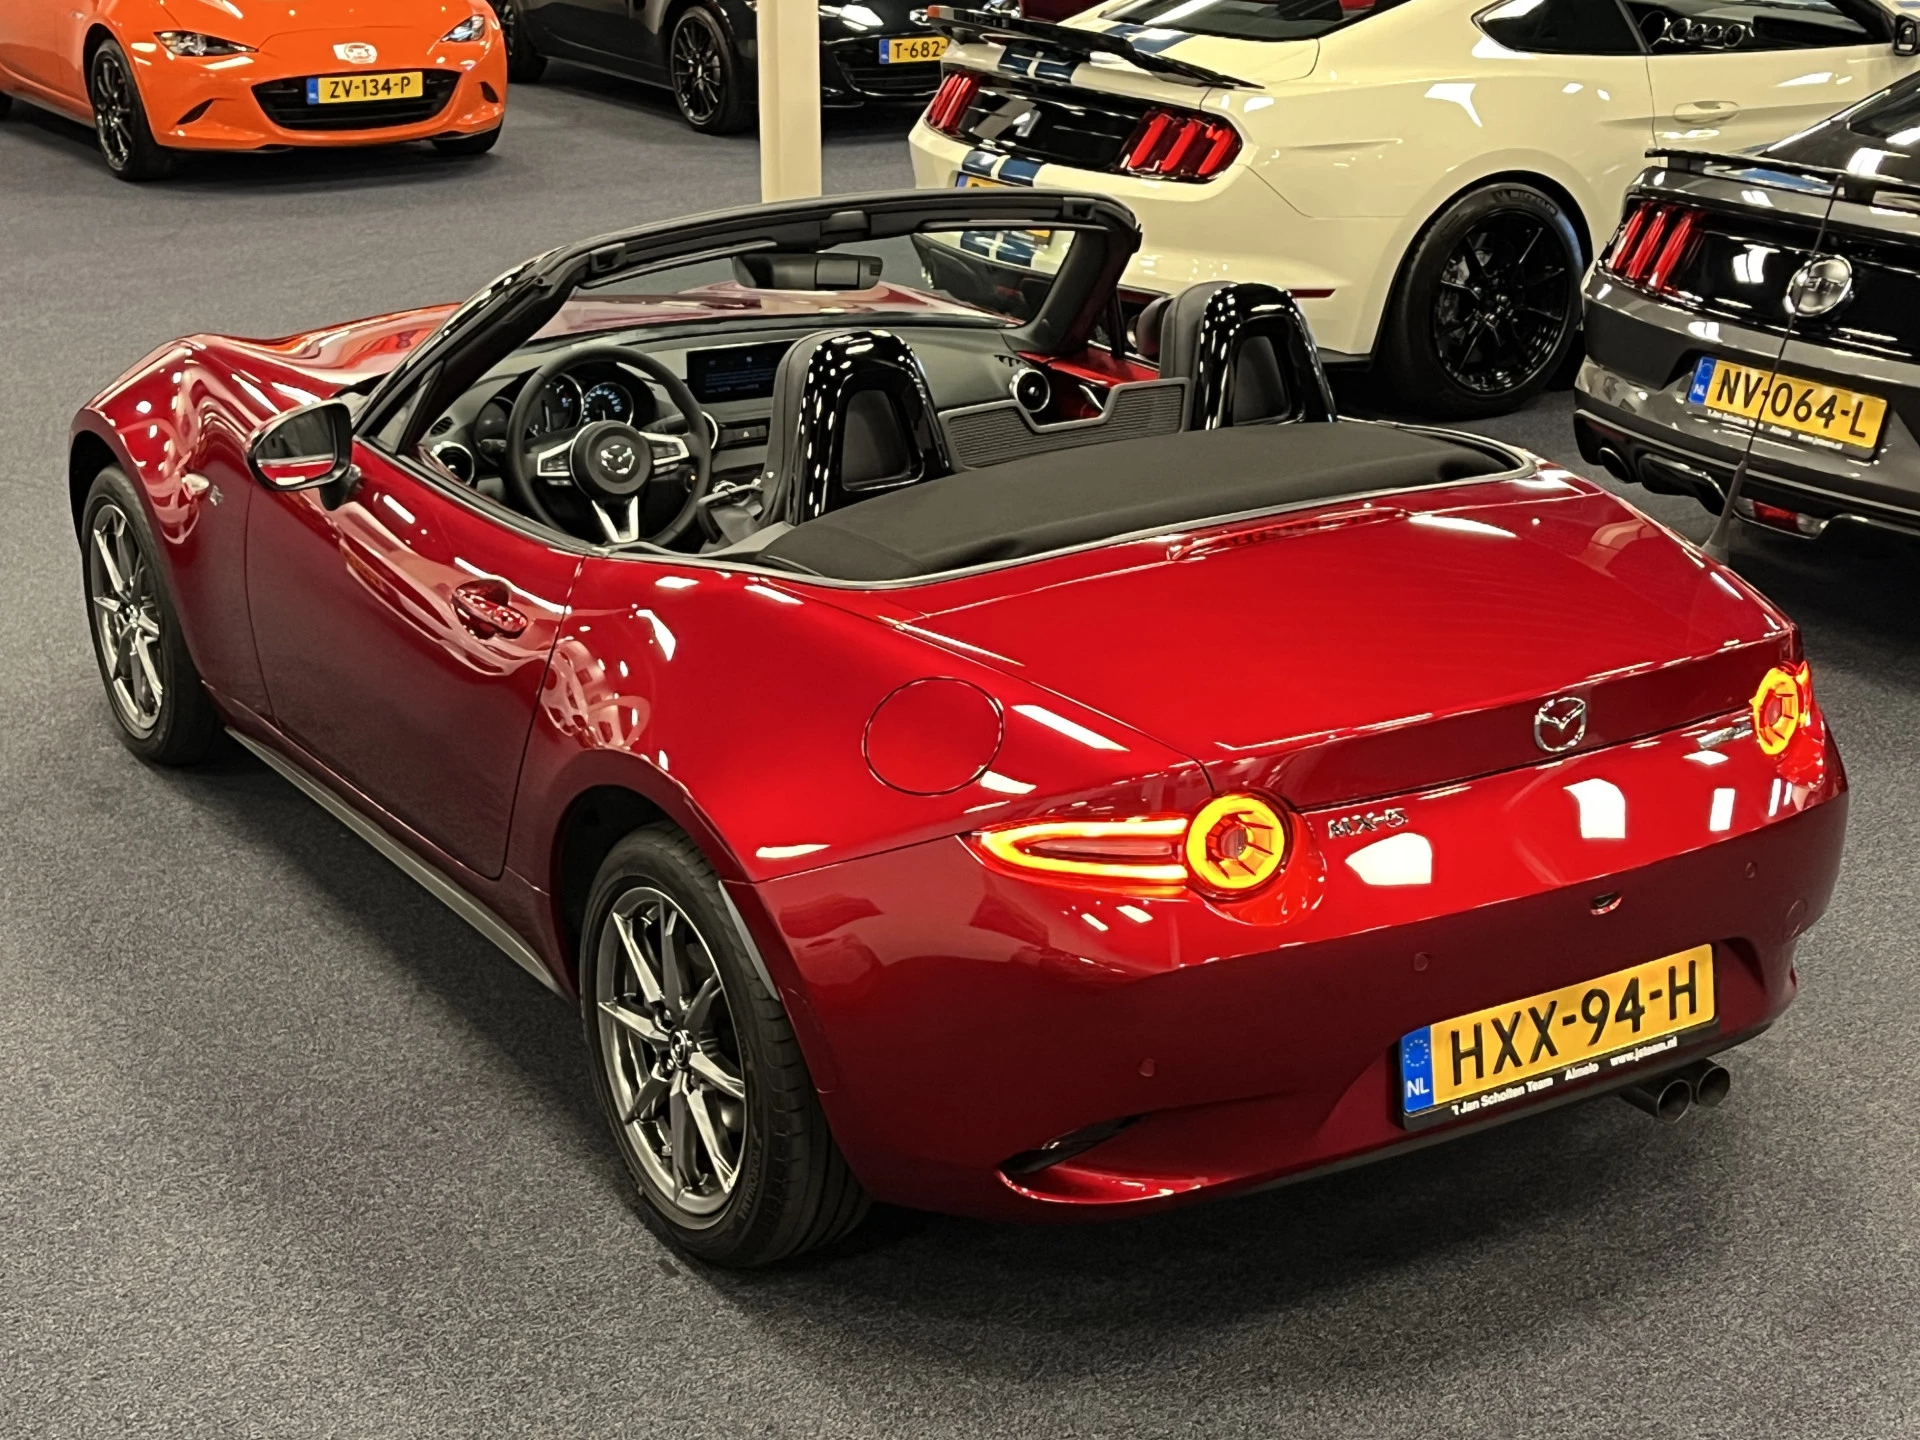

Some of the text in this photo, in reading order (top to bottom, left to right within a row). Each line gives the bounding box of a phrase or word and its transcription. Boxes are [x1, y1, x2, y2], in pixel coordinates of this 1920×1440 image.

[329, 76, 411, 99] ZV-134-P
[1717, 369, 1866, 437] NV-064-L
[1328, 808, 1408, 839] MX-5
[1450, 960, 1697, 1086] HXX-94-H
[1406, 1077, 1430, 1098] NL
[1460, 1101, 1481, 1114] Jan
[1525, 1077, 1554, 1093] Team
